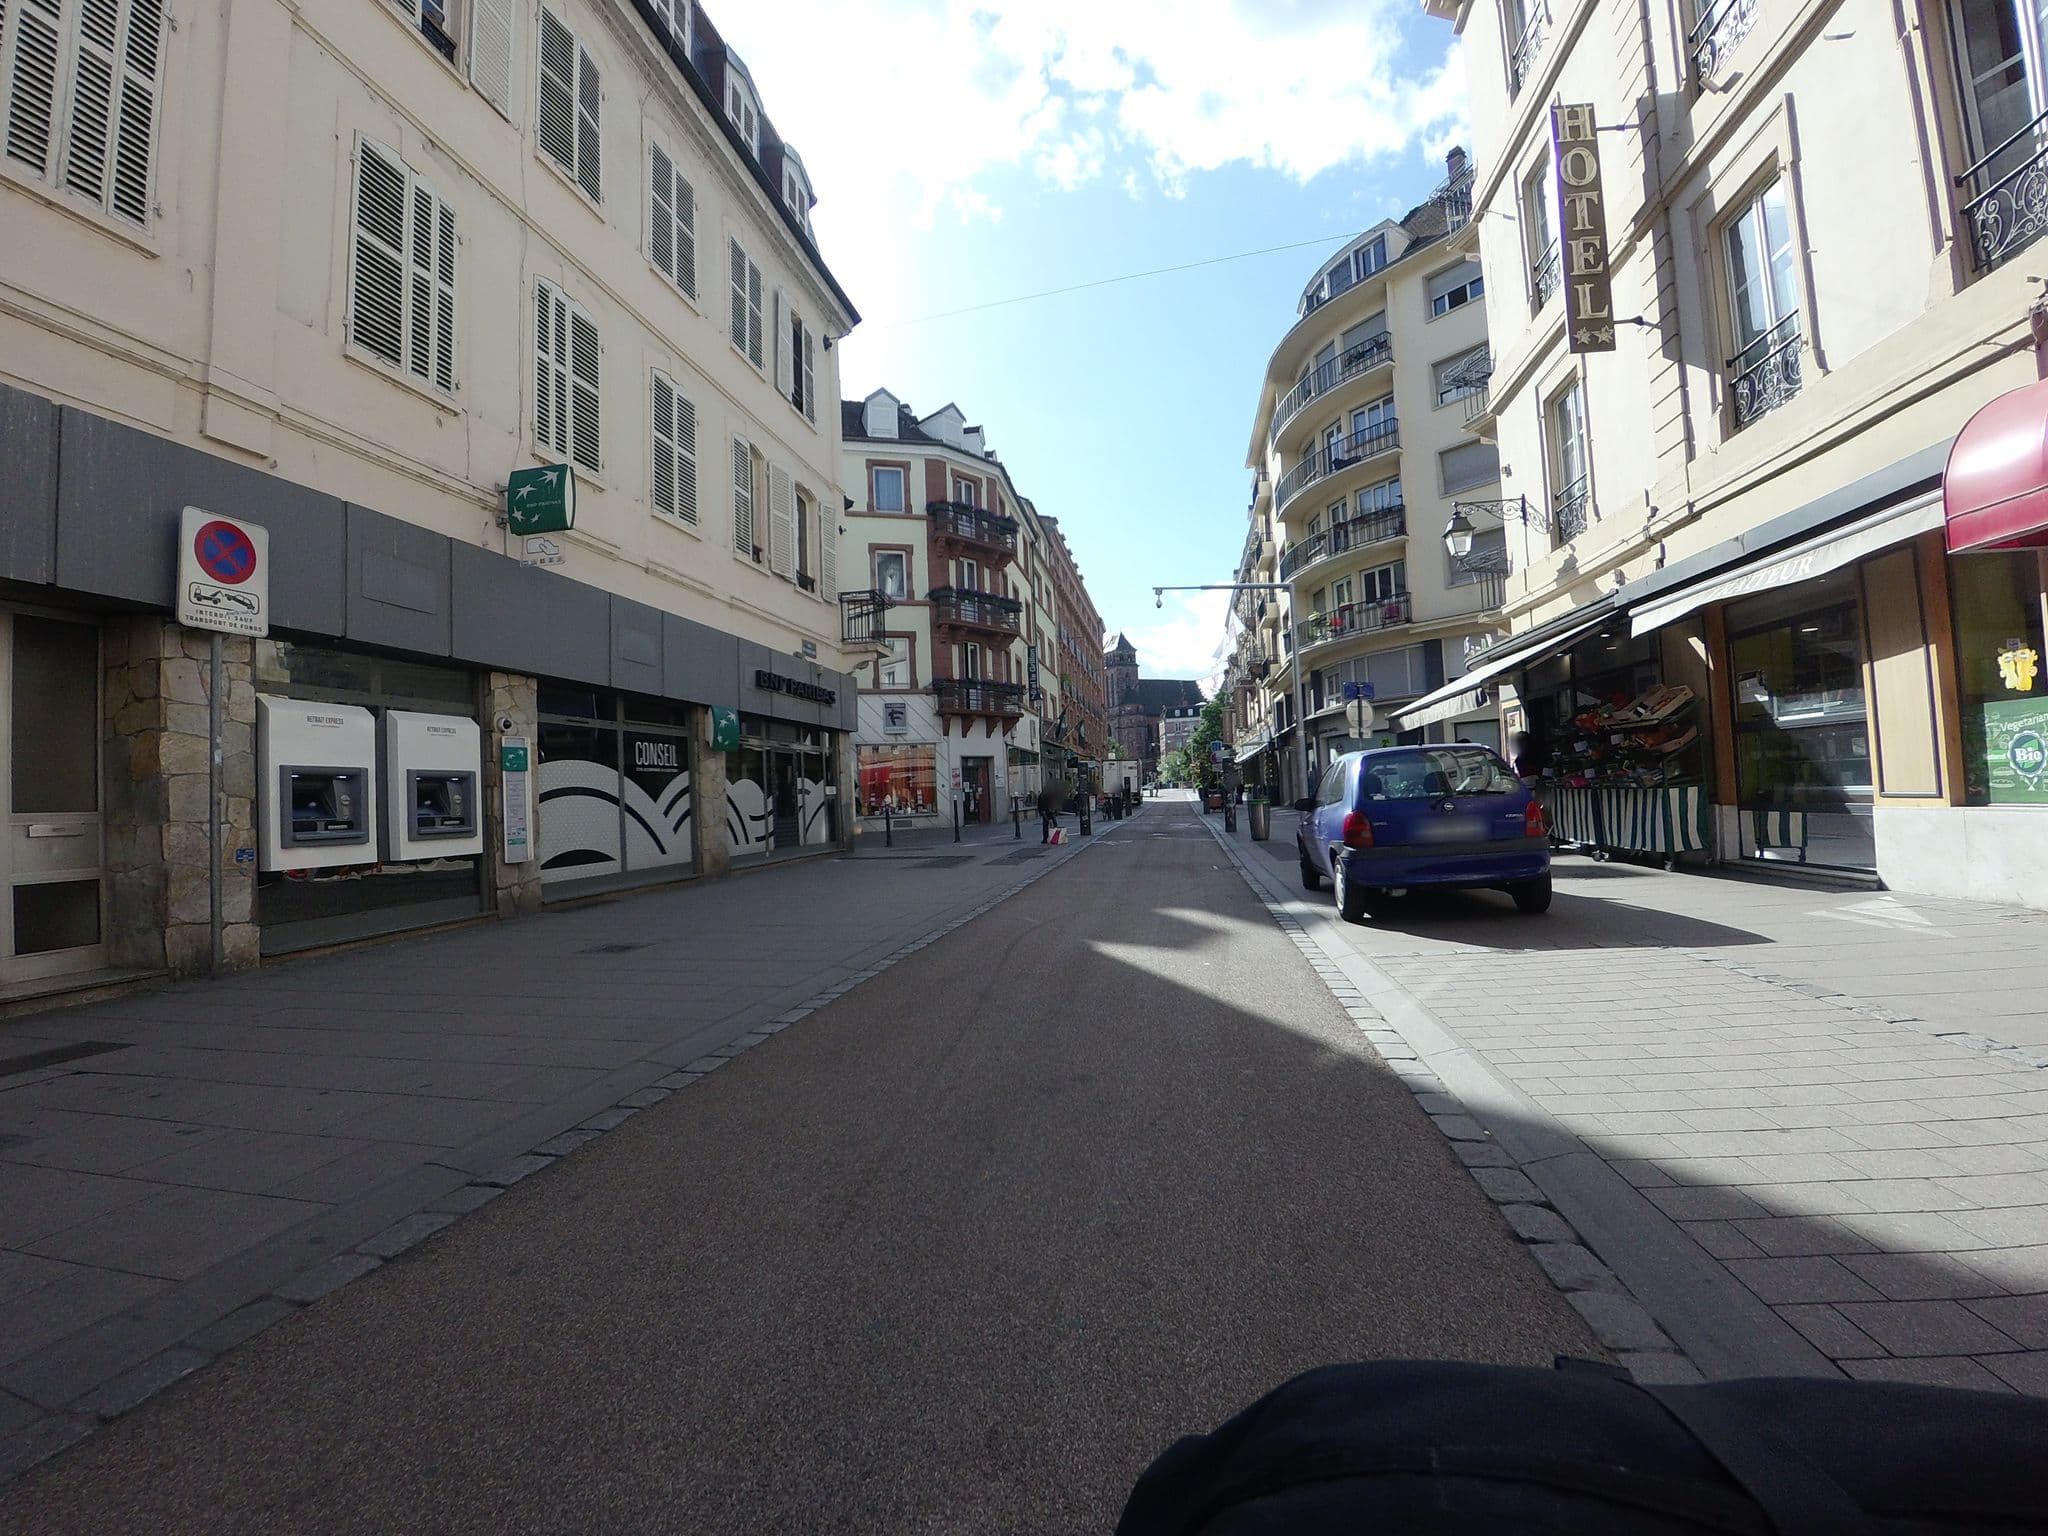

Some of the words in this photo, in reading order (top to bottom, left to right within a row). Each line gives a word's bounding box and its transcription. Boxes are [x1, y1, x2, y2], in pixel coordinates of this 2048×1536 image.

[1553, 102, 1609, 320] HOTEL
[185, 614, 227, 627] TRANSPORT
[229, 621, 238, 629] DE
[240, 624, 263, 633] FONDS
[234, 615, 254, 624] SAUF
[2000, 712, 2048, 732] Vegetarian
[635, 741, 679, 767] CONSEIL
